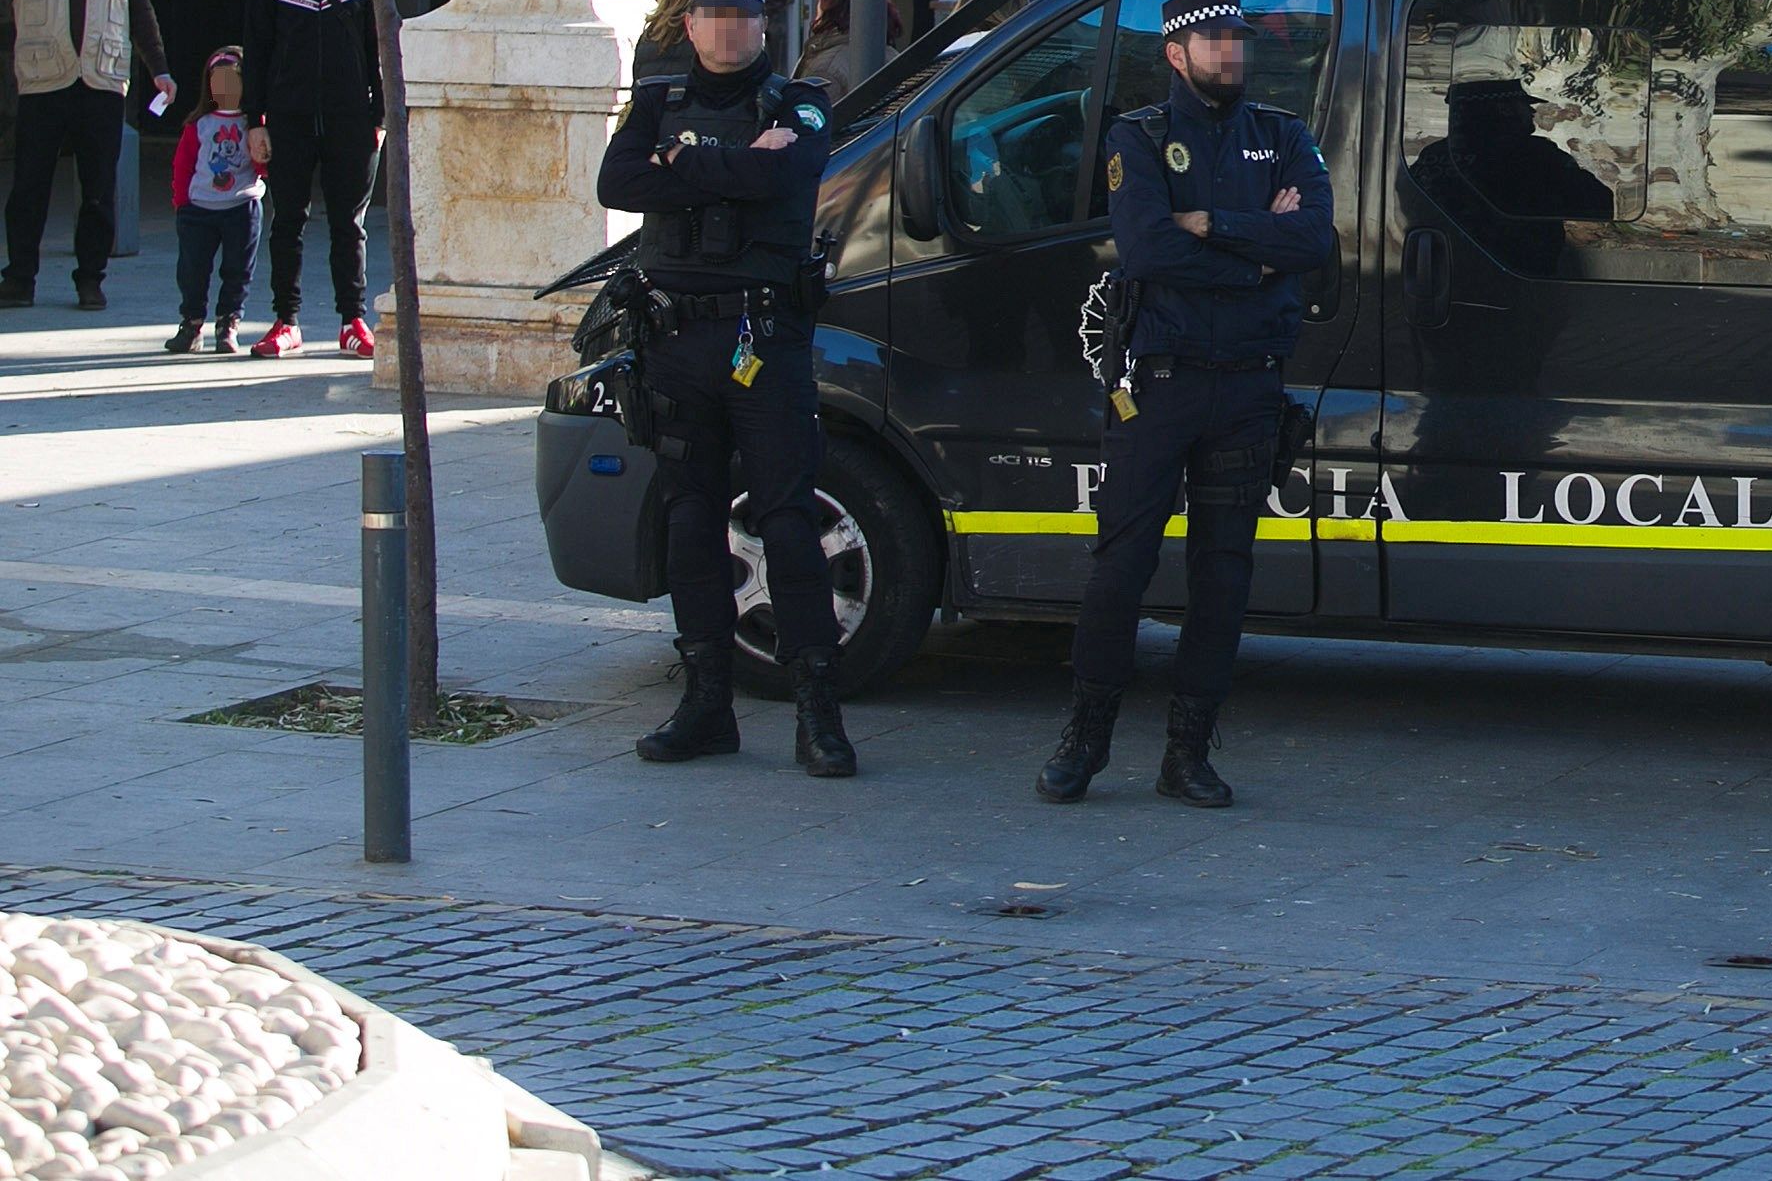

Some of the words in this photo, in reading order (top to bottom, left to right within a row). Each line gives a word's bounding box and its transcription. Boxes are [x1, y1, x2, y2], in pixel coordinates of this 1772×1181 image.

[988, 454, 1021, 465] dCi
[1026, 456, 1053, 468] 115
[1070, 463, 1411, 522] PCIA
